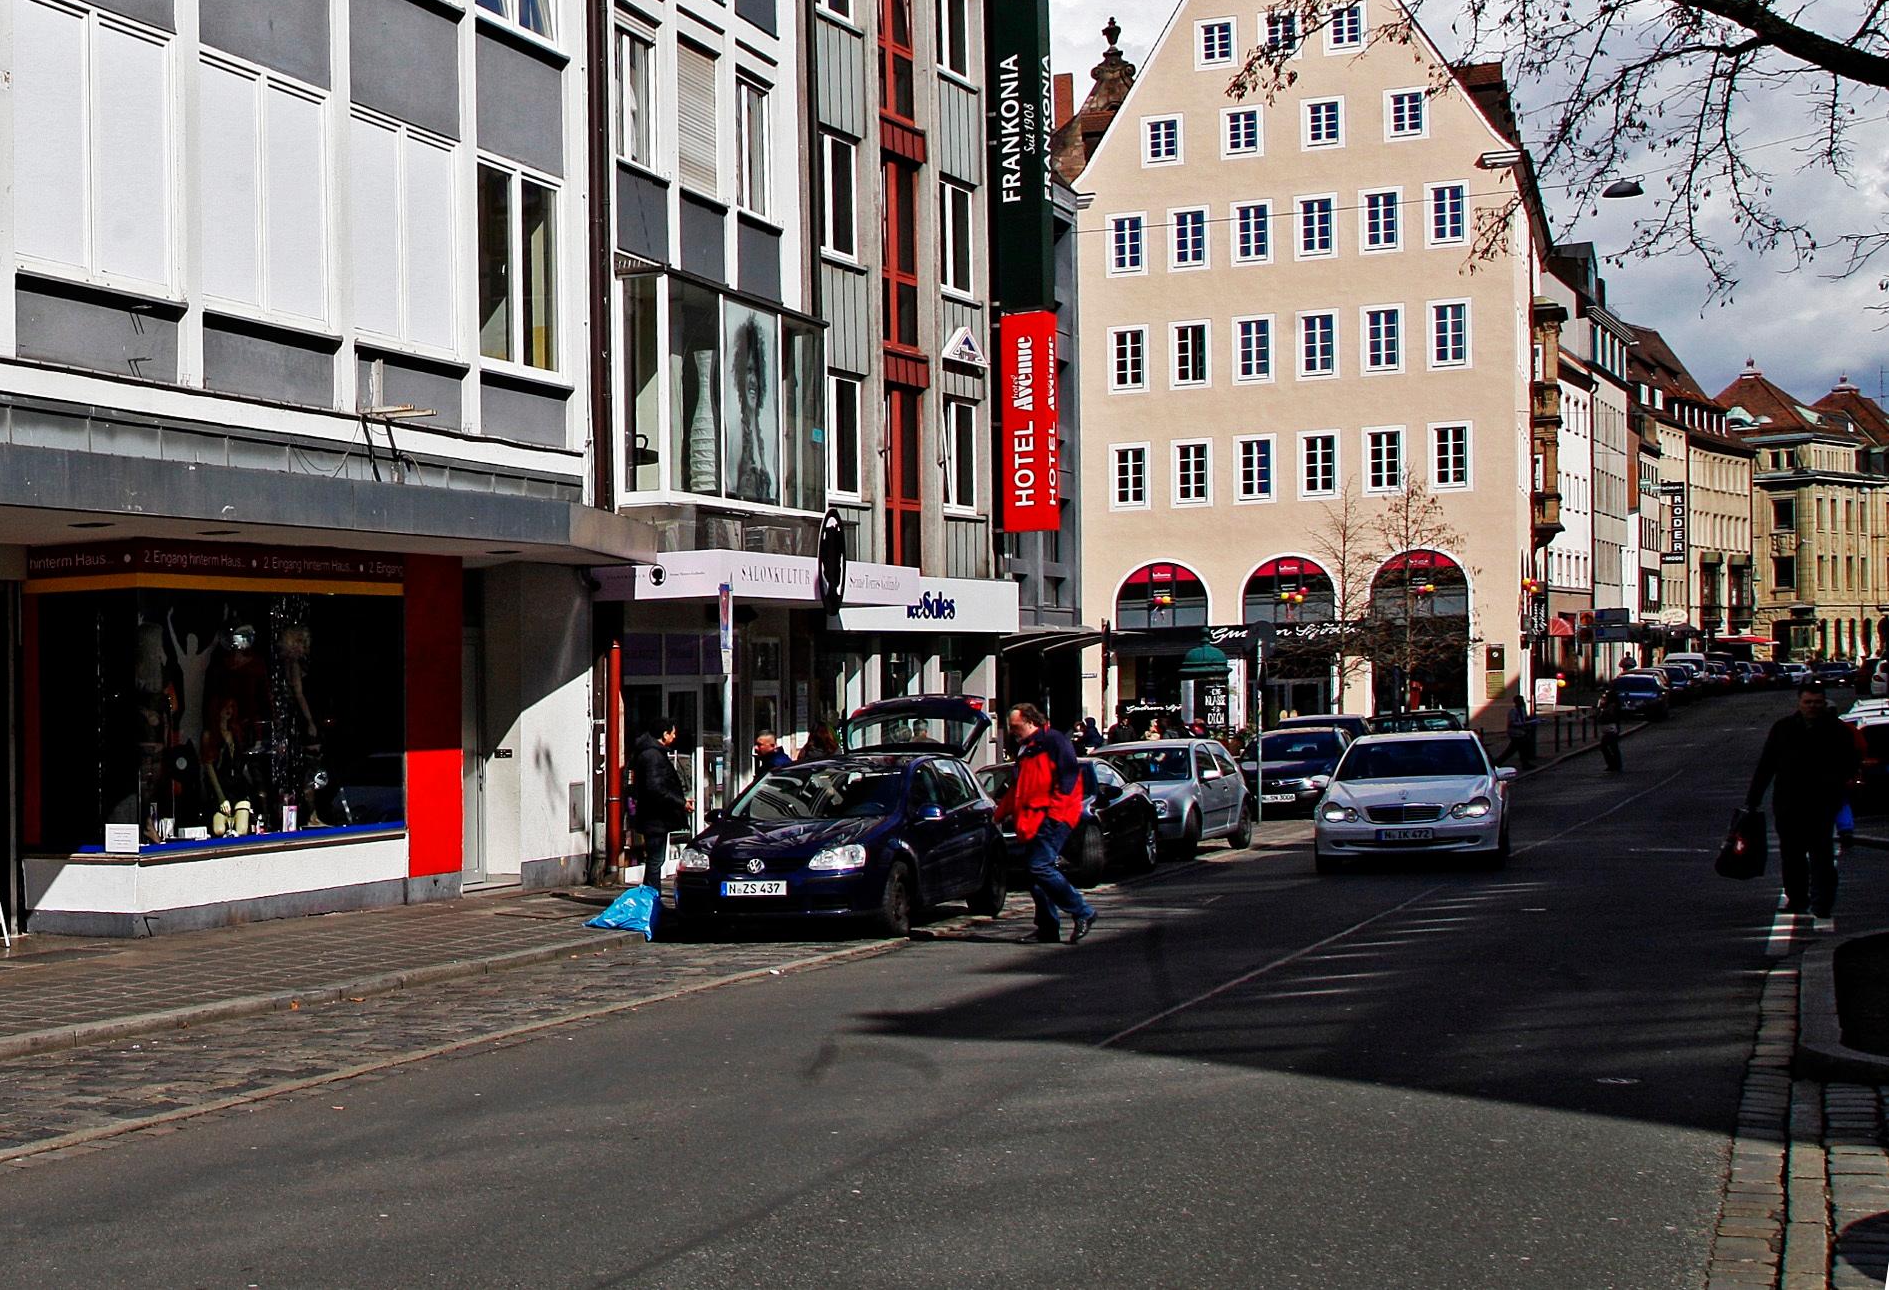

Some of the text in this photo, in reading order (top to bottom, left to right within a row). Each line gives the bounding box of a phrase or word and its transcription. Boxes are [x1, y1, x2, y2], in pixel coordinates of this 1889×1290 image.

[999, 53, 1021, 204] FRANKONIA
[1023, 102, 1036, 155] Seit 1908
[1041, 54, 1052, 202] FRANKONIA
[1013, 335, 1035, 507] HOTEL Avenue
[1047, 420, 1057, 506] HOTEL
[29, 557, 72, 570] hinterm
[153, 550, 188, 568] Eingang
[189, 553, 220, 566] hinterm
[272, 557, 302, 573] Eingang
[376, 562, 404, 577] Eingang
[741, 564, 810, 585] SALONKULTUR
[742, 883, 758, 894] ZS
[760, 882, 781, 894] 437
